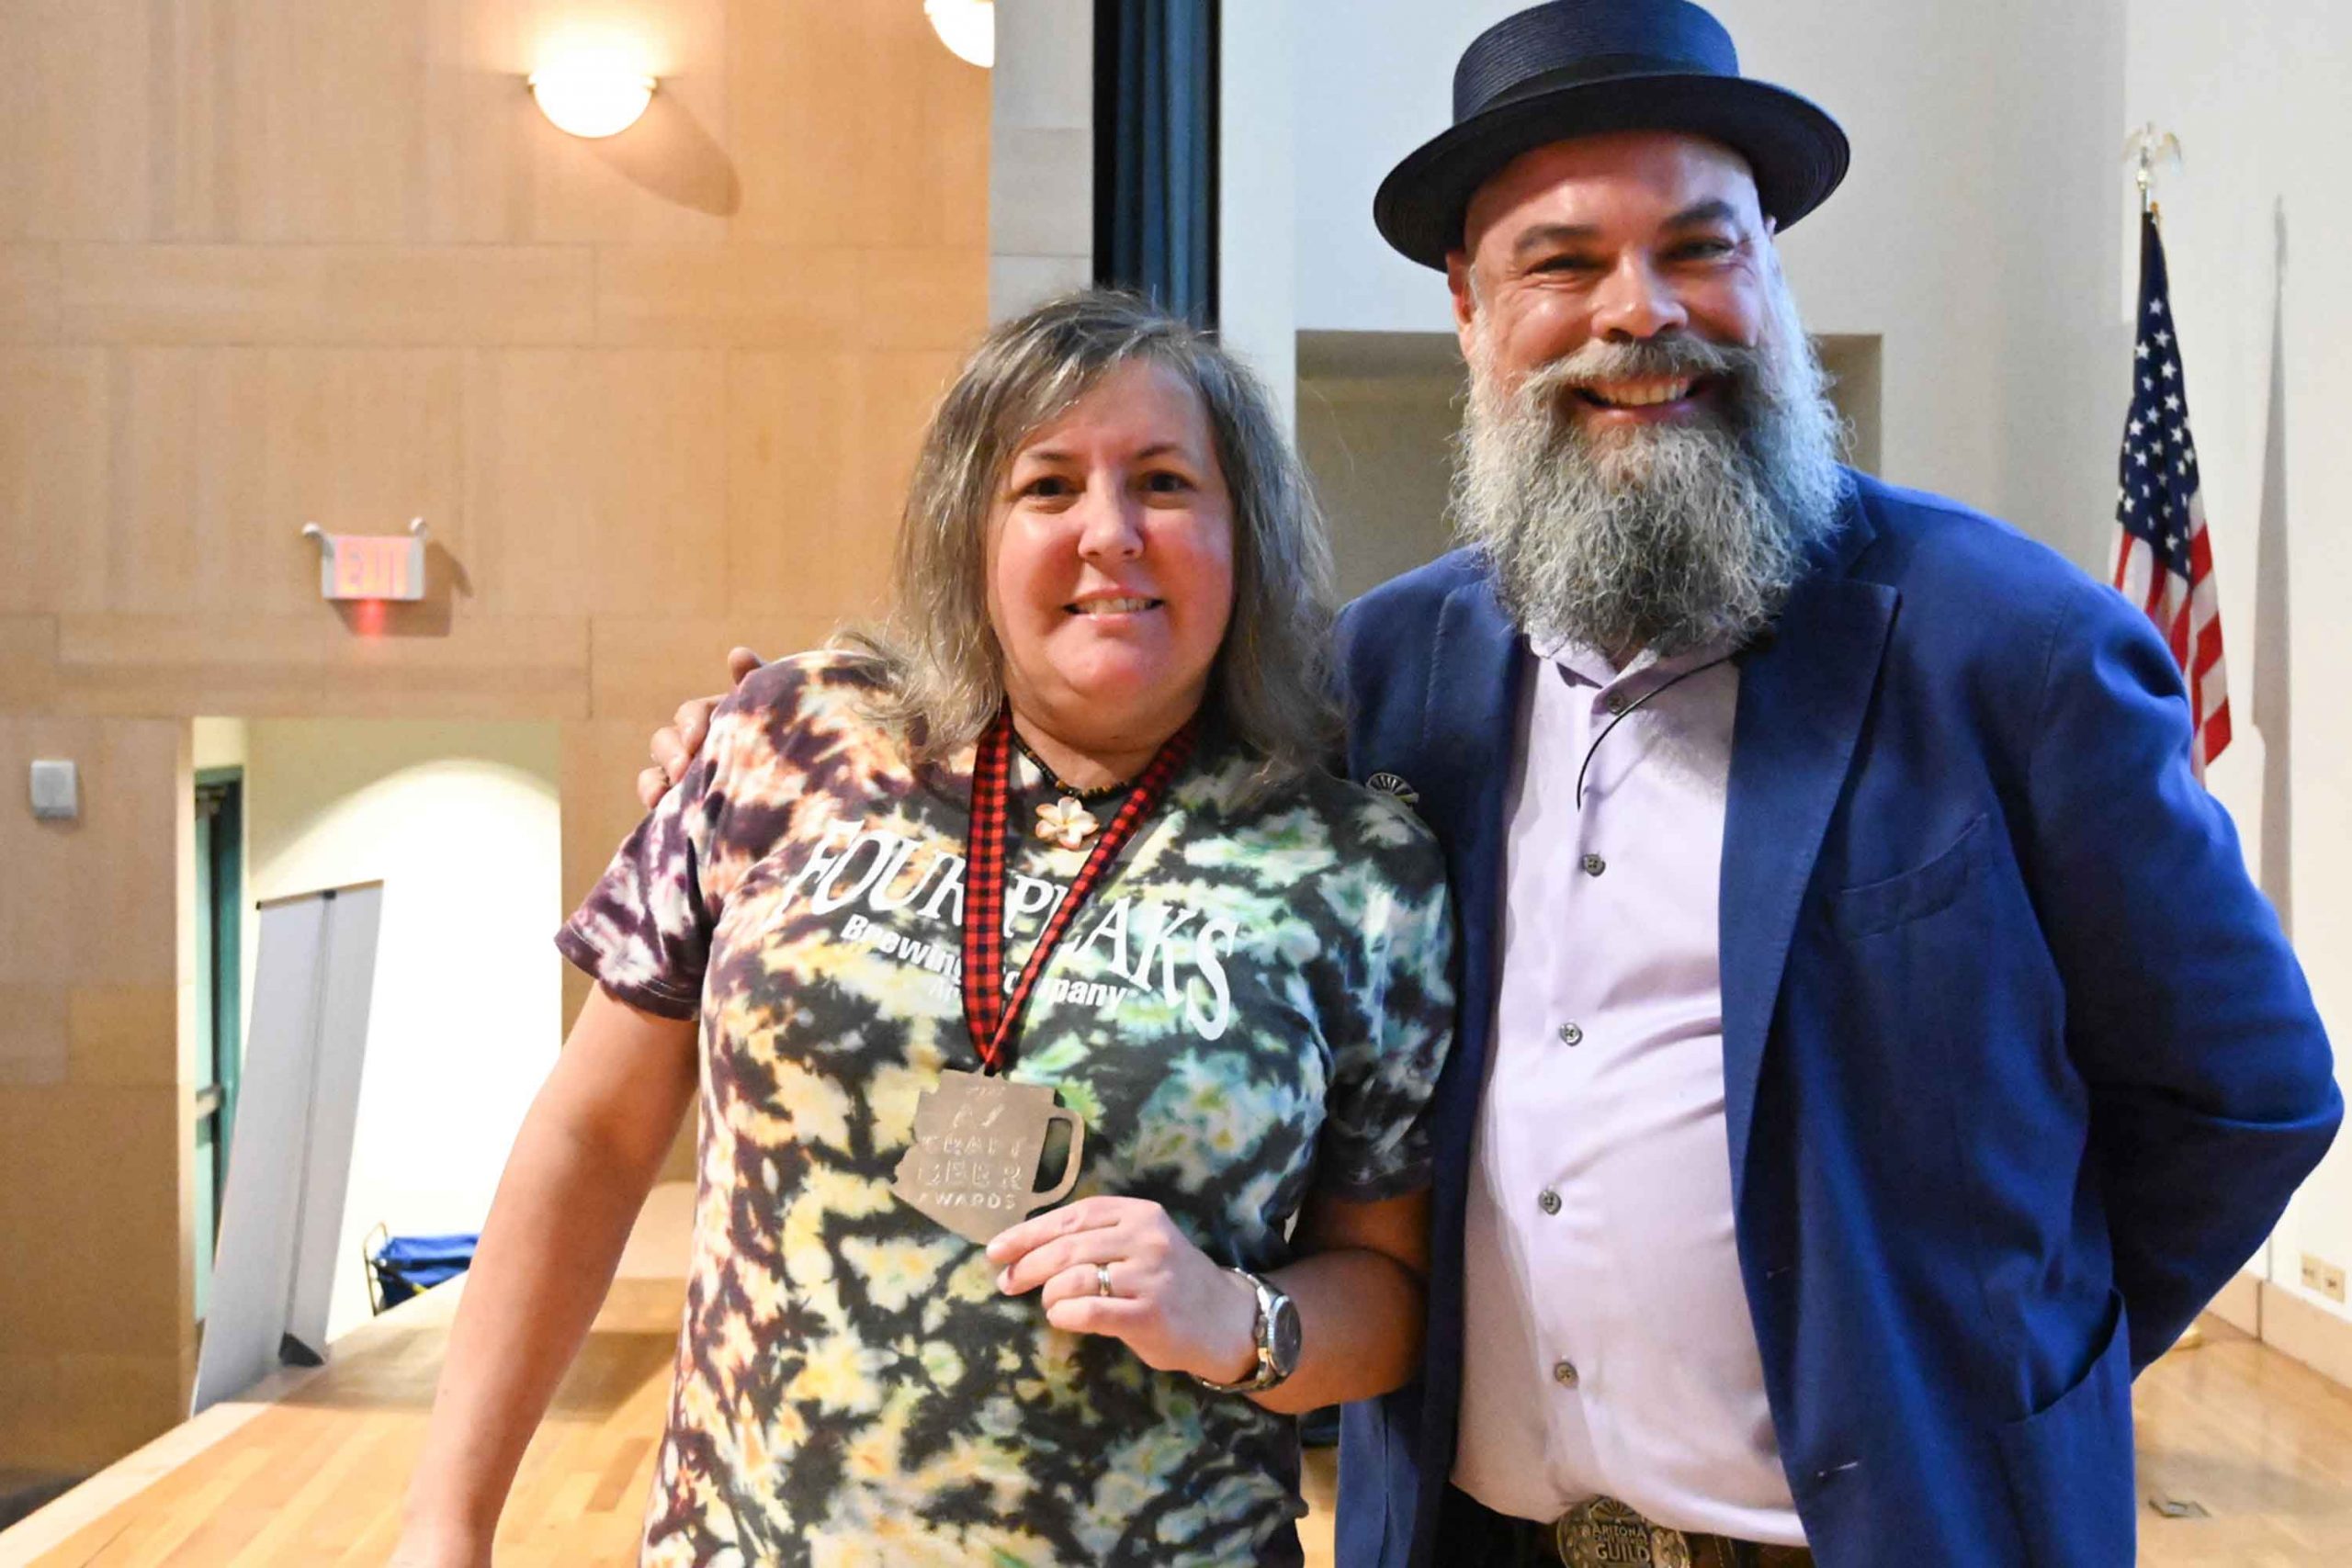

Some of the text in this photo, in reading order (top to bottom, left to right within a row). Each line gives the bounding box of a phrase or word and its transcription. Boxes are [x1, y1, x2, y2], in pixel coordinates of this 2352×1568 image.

[779, 818, 966, 926] FOUR
[840, 913, 962, 986] Brewing
[1002, 965, 1128, 1010] opany
[1595, 1543, 1651, 1563] GUILD
